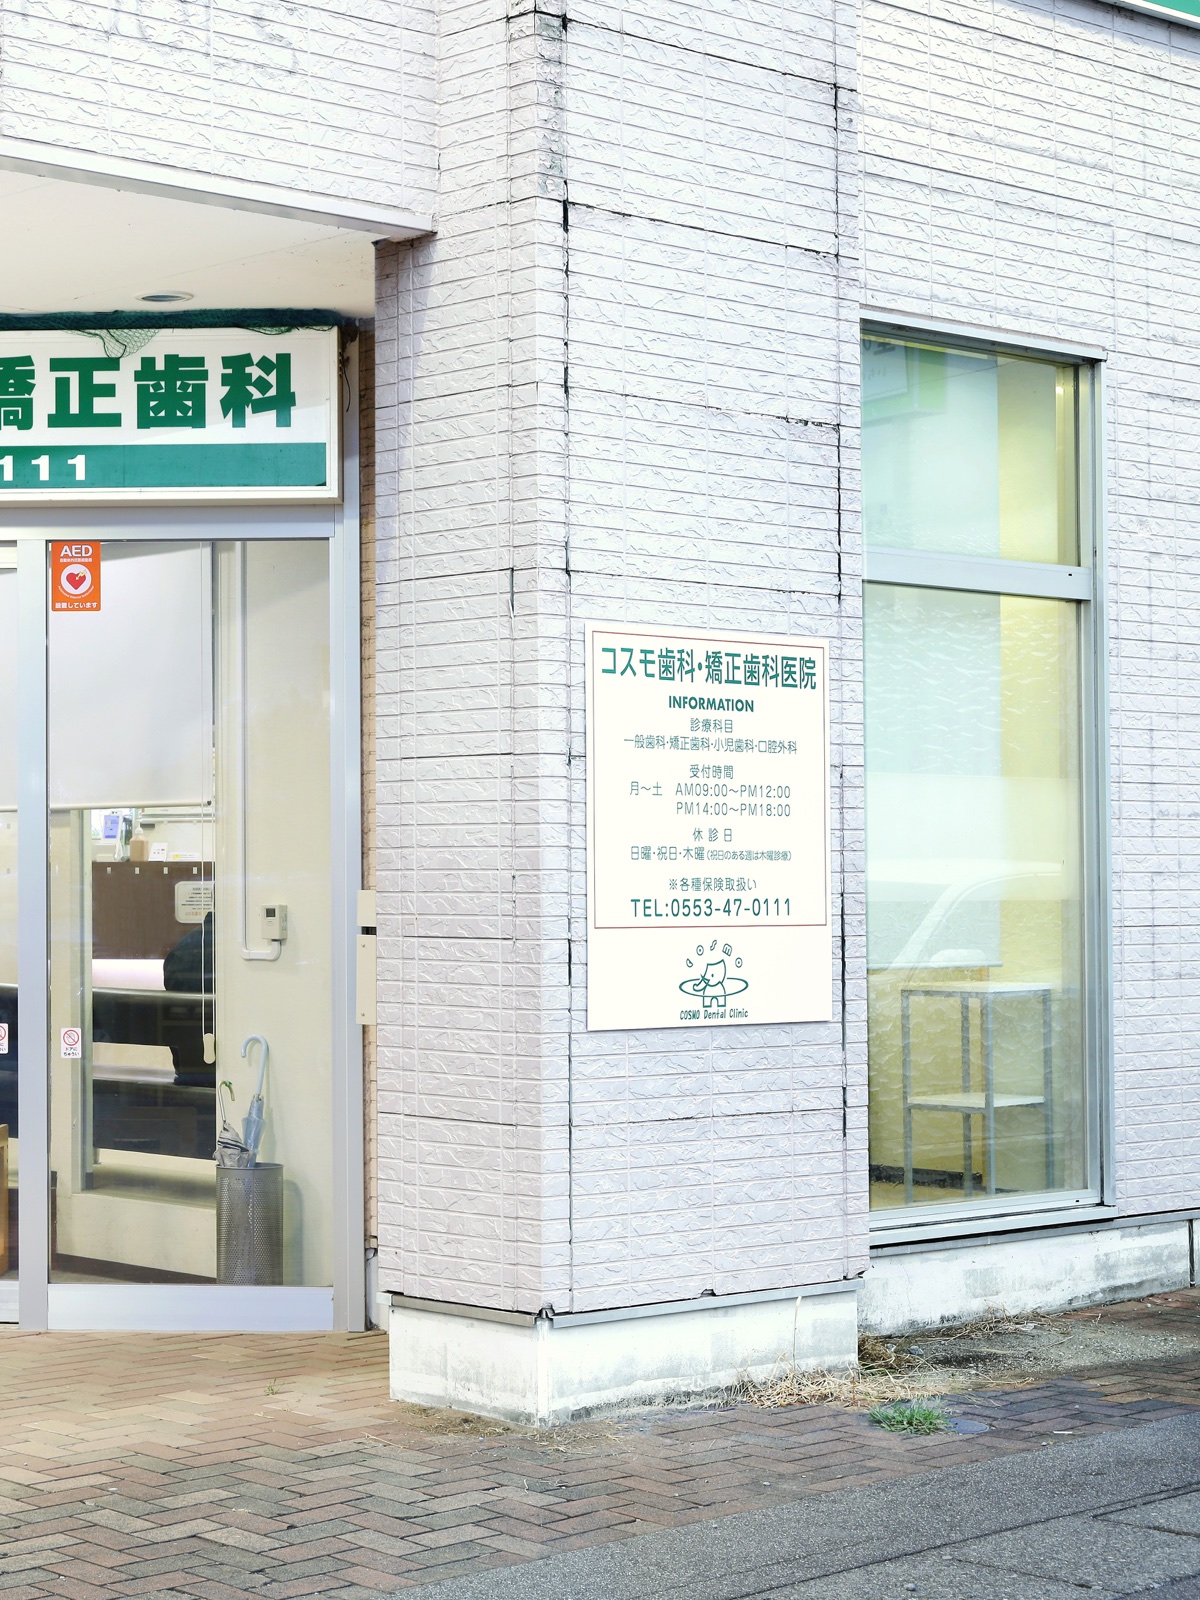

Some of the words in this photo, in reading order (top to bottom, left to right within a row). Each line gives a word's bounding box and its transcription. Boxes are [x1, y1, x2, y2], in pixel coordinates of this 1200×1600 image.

[60, 545, 93, 557] AED
[601, 647, 817, 690] コスモ歯科・矯正歯科医院
[669, 696, 754, 712] INFORMATION
[690, 718, 733, 733] 診療科目
[689, 764, 734, 779] 受付時間
[631, 898, 791, 917] TEL:0553-47-0111
[680, 1010, 700, 1020] COSMO
[703, 1008, 726, 1020] Dental
[729, 1008, 748, 1019] Clinic
